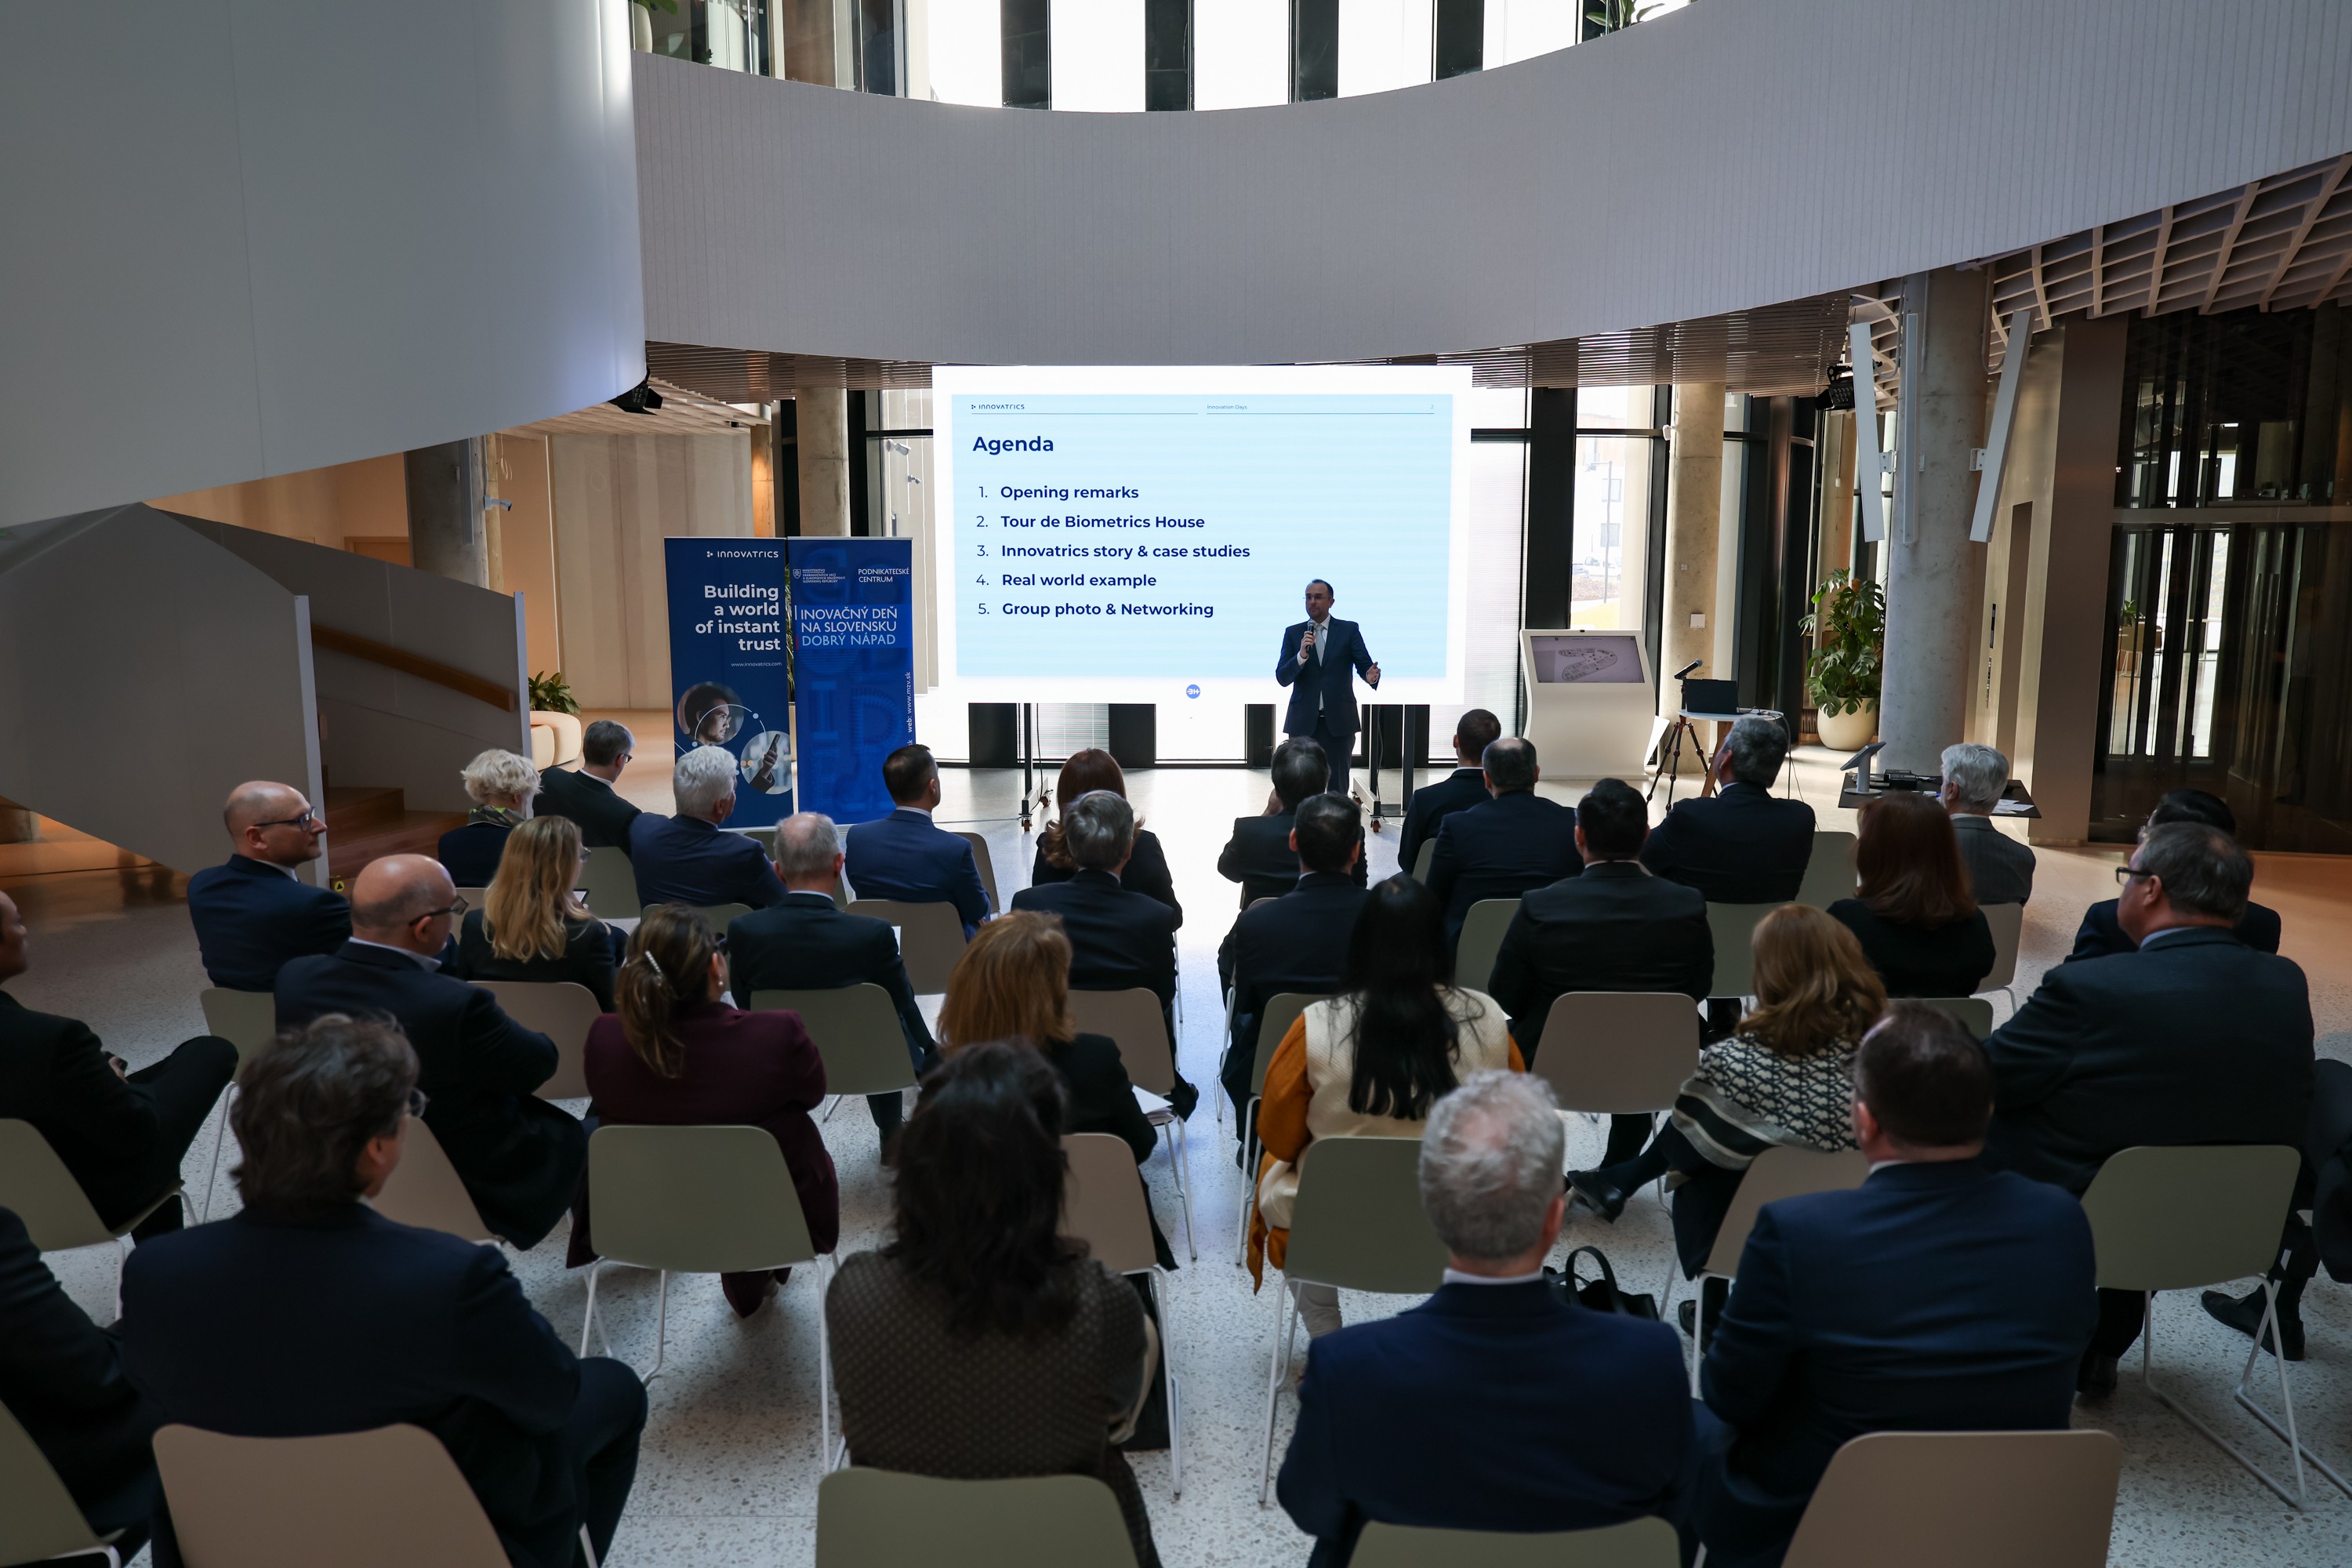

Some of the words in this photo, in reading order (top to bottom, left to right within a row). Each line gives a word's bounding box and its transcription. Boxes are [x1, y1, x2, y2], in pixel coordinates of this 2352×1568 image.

[972, 435, 1054, 456] Agenda
[978, 486, 988, 498] 1.
[1000, 485, 1069, 502] Opening
[1074, 485, 1139, 499] remarks
[976, 515, 989, 528] 2.
[1000, 515, 1036, 528] Tour
[1040, 515, 1061, 528] de
[1065, 514, 1151, 528] Biometrics
[1156, 515, 1205, 528] House
[977, 545, 989, 557] 3.
[1002, 543, 1090, 557] Innovatrics
[1093, 545, 1134, 561] story
[1137, 545, 1149, 557] &
[1152, 547, 1189, 557] case
[1192, 544, 1250, 557] studies
[975, 574, 989, 586] 4.
[1002, 573, 1036, 586] Real
[1040, 573, 1085, 586] world
[1089, 573, 1157, 590] example
[704, 583, 779, 601] Building
[713, 606, 724, 616] a
[728, 601, 779, 616] world
[800, 605, 869, 620] INOVAČNÝ
[872, 605, 898, 619] DEŇ
[978, 603, 990, 615] 5.
[1002, 603, 1051, 618] Group
[1055, 602, 1102, 618] photo
[1105, 603, 1116, 615] &
[1121, 602, 1214, 619] Networking
[695, 619, 714, 634] of
[717, 619, 781, 633] instant
[801, 622, 822, 633] NA
[824, 621, 897, 633] SLOVENSKU
[738, 638, 781, 651] trust
[802, 632, 846, 647] DOBRÝ
[851, 632, 896, 645] NÁPAD
